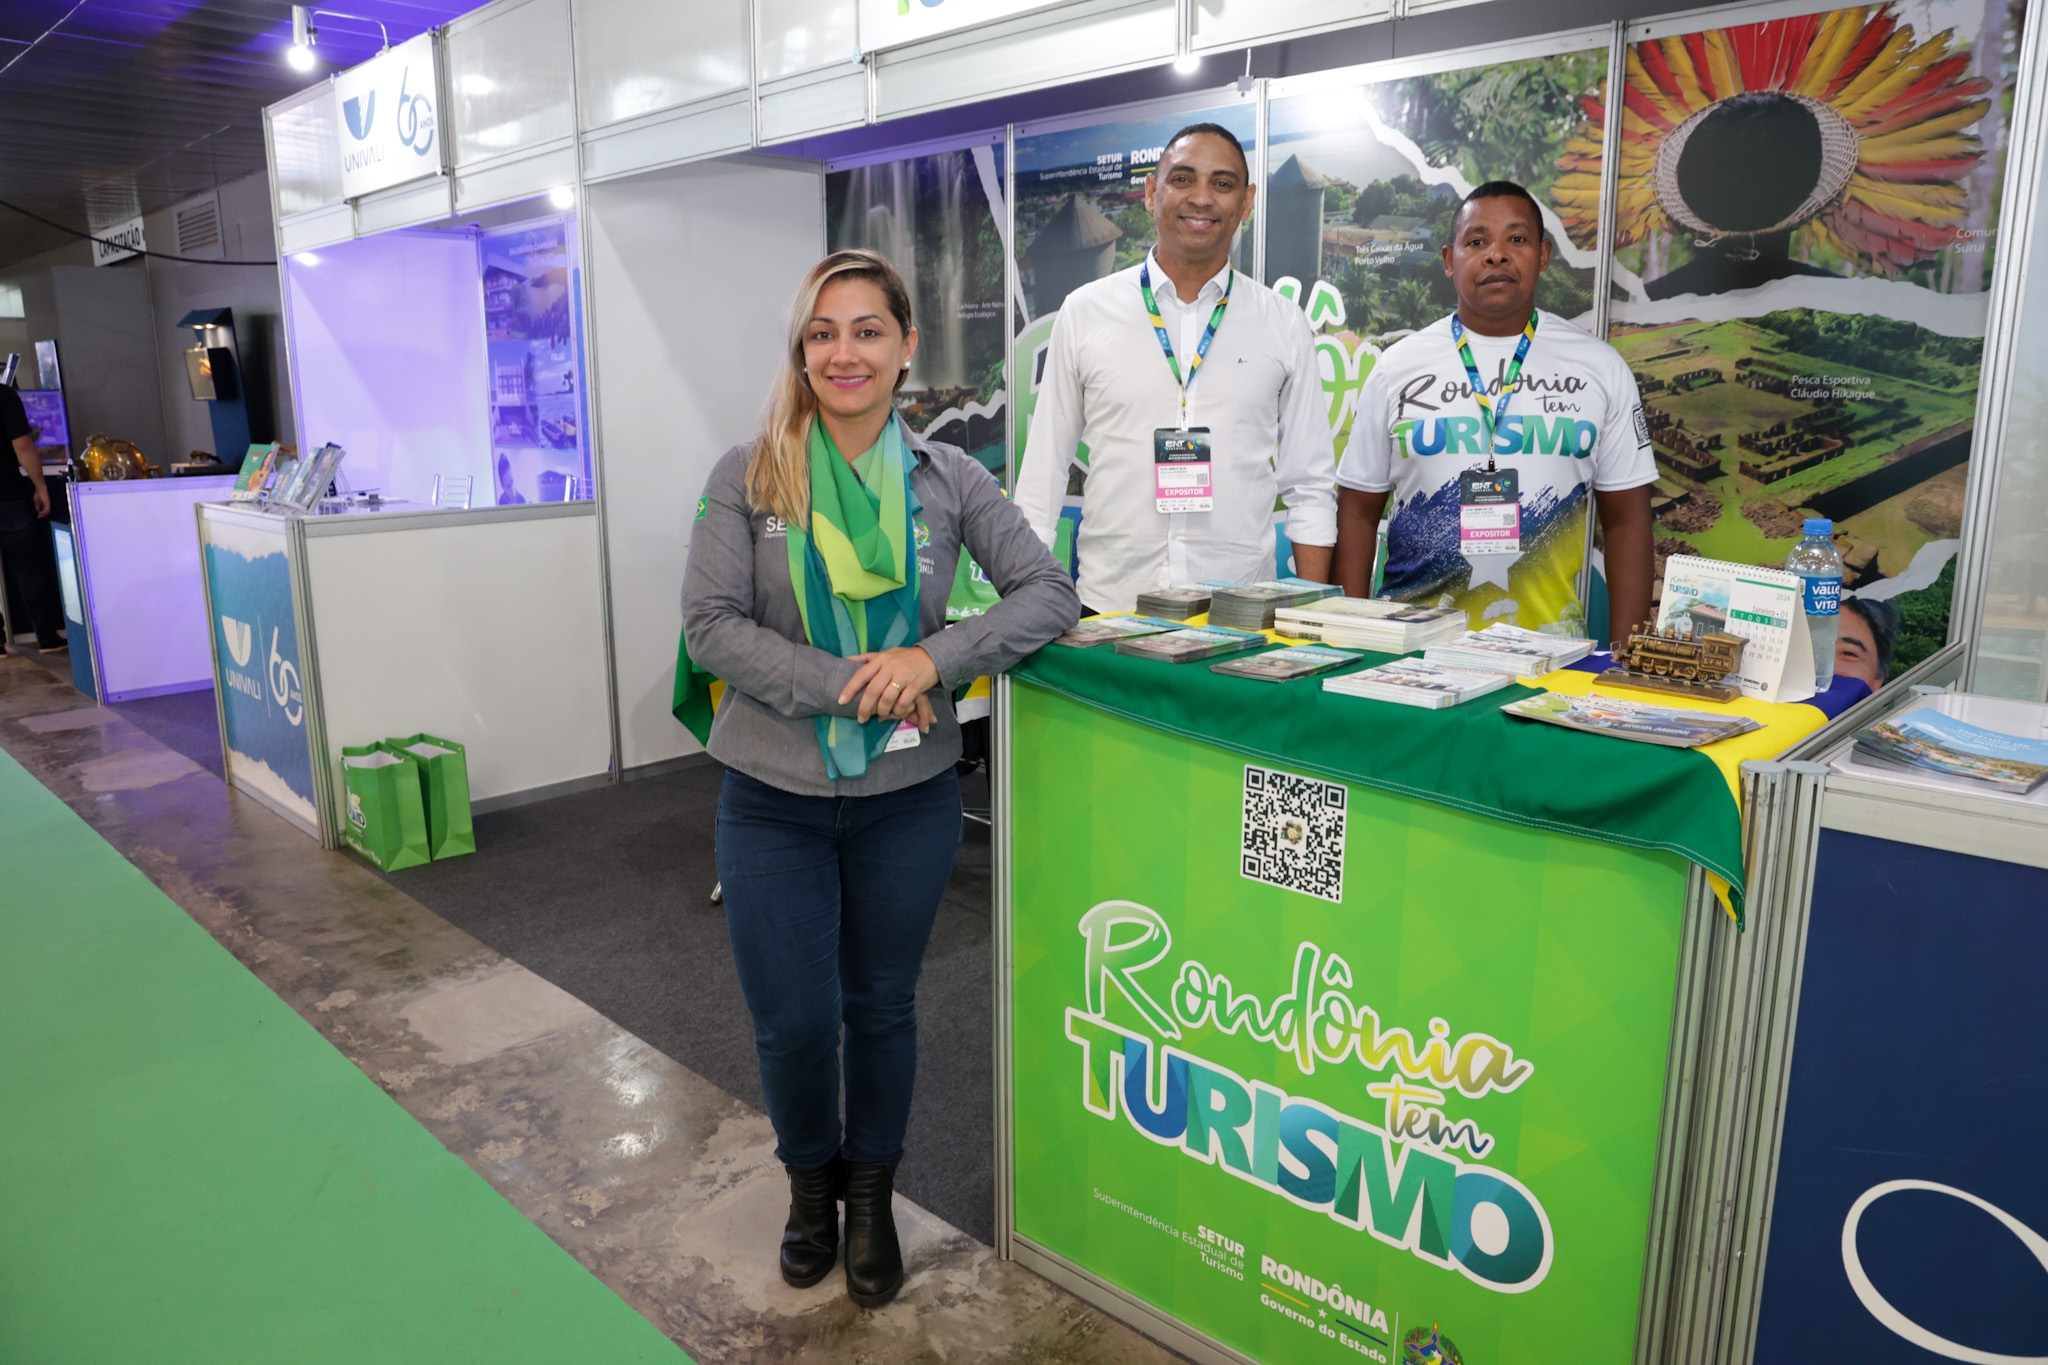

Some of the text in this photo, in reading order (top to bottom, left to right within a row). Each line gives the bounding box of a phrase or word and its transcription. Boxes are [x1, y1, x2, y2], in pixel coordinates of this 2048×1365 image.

[344, 143, 385, 173] UNIVALI
[1096, 146, 1165, 165] SETUR ROND
[1088, 164, 1113, 174] Estadual
[1114, 163, 1122, 172] de
[1098, 171, 1122, 180] Turismo
[1370, 244, 1392, 253] Caixas
[1394, 242, 1403, 252] da
[1404, 240, 1424, 252] Água
[1355, 256, 1394, 266] Porto Velho
[1792, 374, 1871, 387] Pesca Esportiva
[1535, 394, 1581, 414] tem
[1790, 388, 1876, 400] Cláudio Hikague
[1392, 414, 1598, 460] TURISMO
[1165, 488, 1204, 496] EXPOSITOR
[1470, 530, 1511, 538] EXPOSITOR
[1776, 593, 1790, 602] 2024
[1752, 604, 1776, 617] Janeiro
[226, 667, 262, 701] UNIVALI
[1078, 900, 1534, 1099] Rondônia
[1366, 1074, 1496, 1159] tem
[1065, 1007, 1554, 1294] TURISMO
[1093, 1187, 1245, 1270] Superintendência Estadual de
[1198, 1224, 1245, 1258] SETUR
[1200, 1251, 1244, 1282] Turismo
[1261, 1254, 1389, 1335] RONDÔNIA
[1260, 1294, 1387, 1364] Governo do Estado
